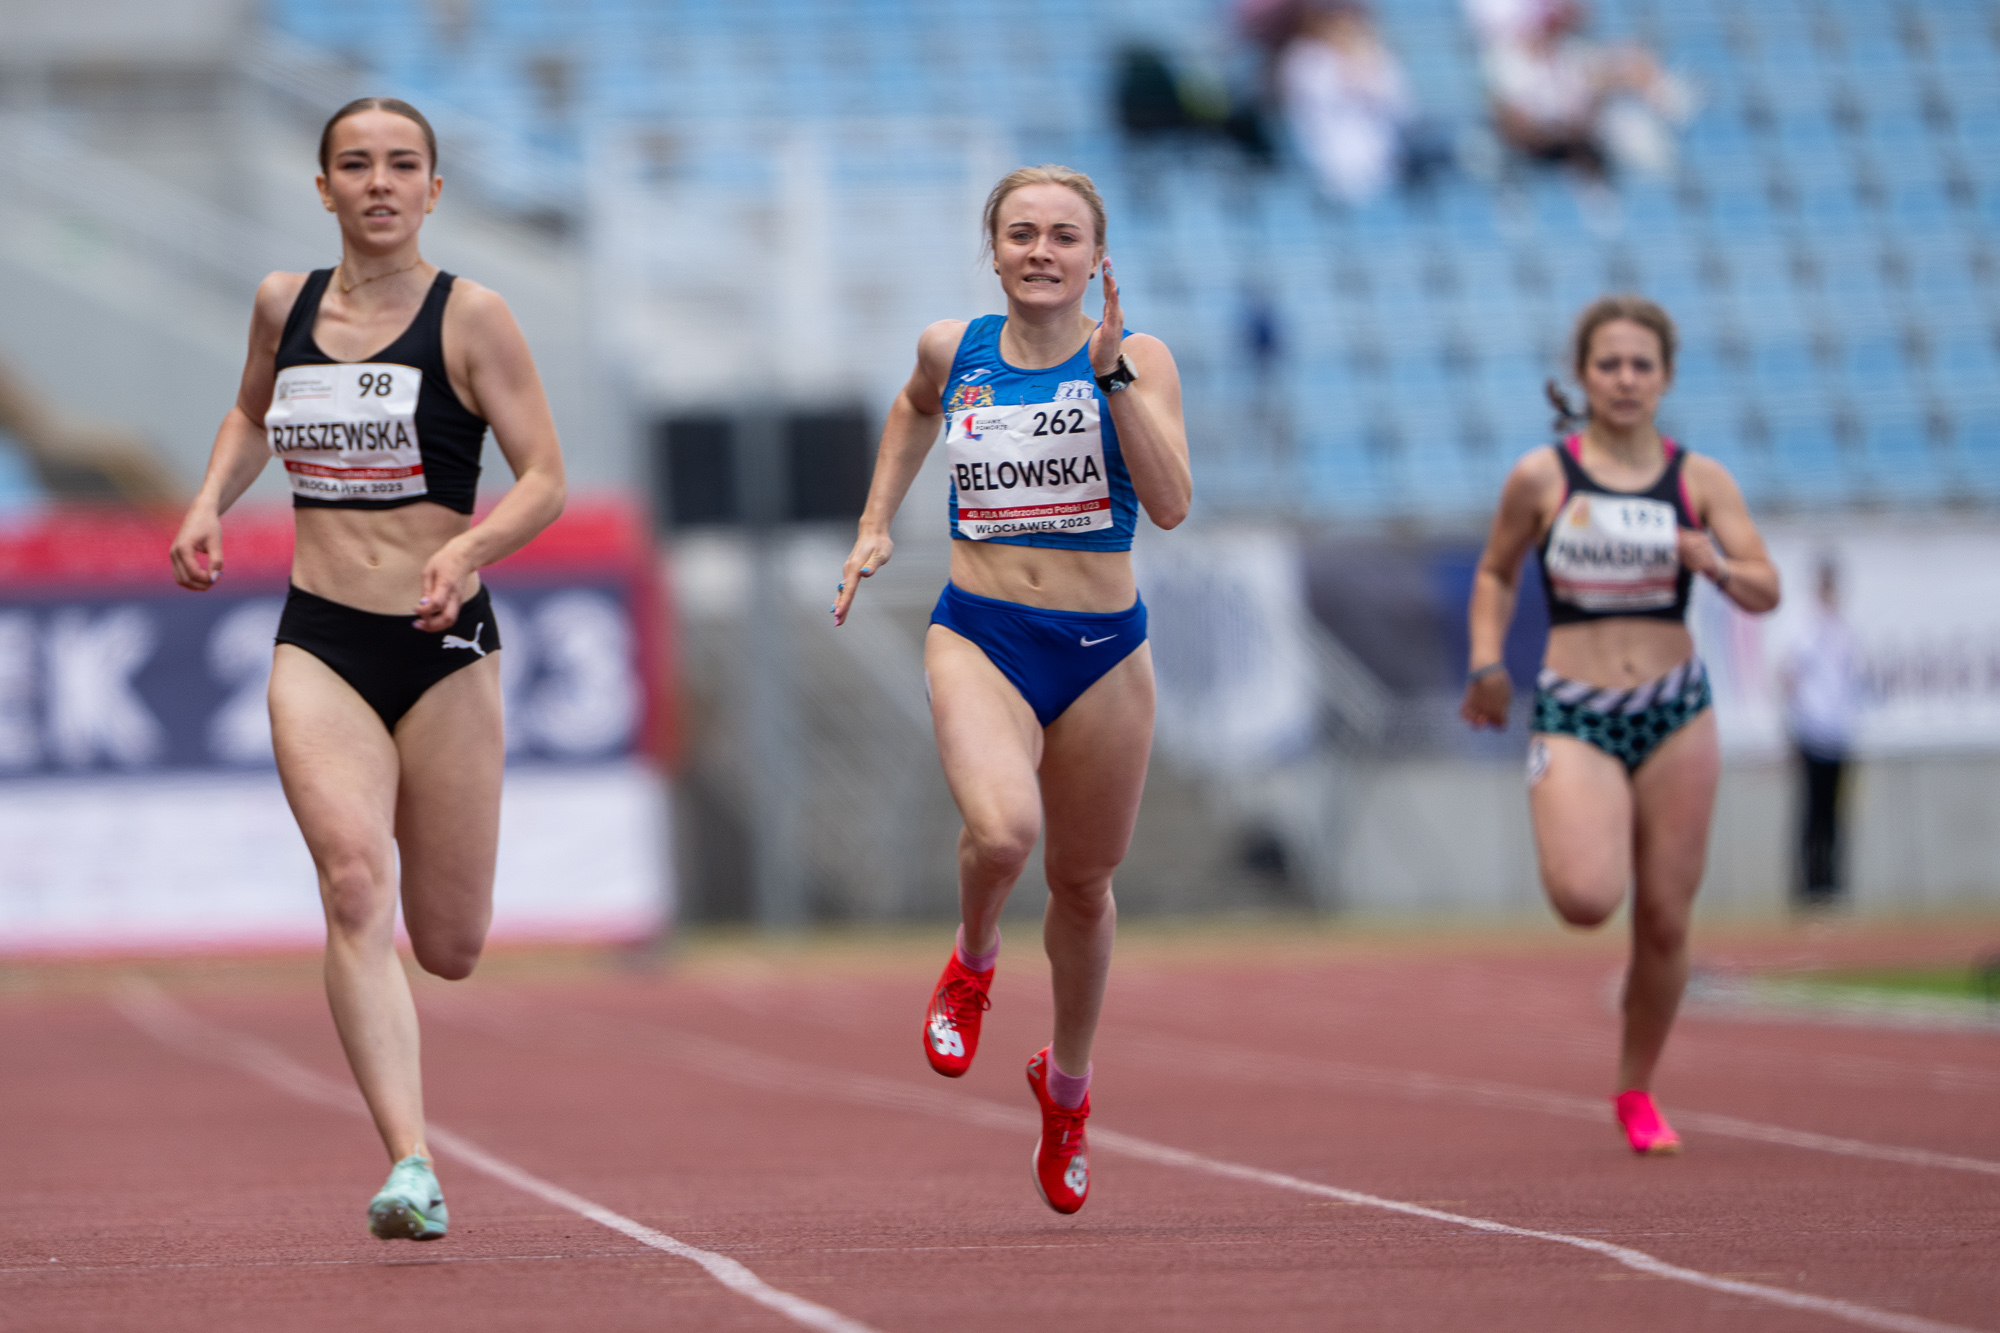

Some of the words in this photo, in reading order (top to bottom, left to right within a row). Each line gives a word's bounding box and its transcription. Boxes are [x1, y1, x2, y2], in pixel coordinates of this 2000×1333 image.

[359, 372, 392, 397] 98
[1033, 408, 1086, 437] 262
[273, 419, 412, 453] RZESZEWSKA
[955, 455, 1101, 491] BELOWSKA
[371, 482, 404, 493] 2023
[999, 505, 1054, 518] Mistrzostwa
[1055, 503, 1081, 514] Polski
[1083, 501, 1100, 511] U23
[976, 520, 1058, 534] WŁOCŁAWEK
[1060, 516, 1091, 529] 2023
